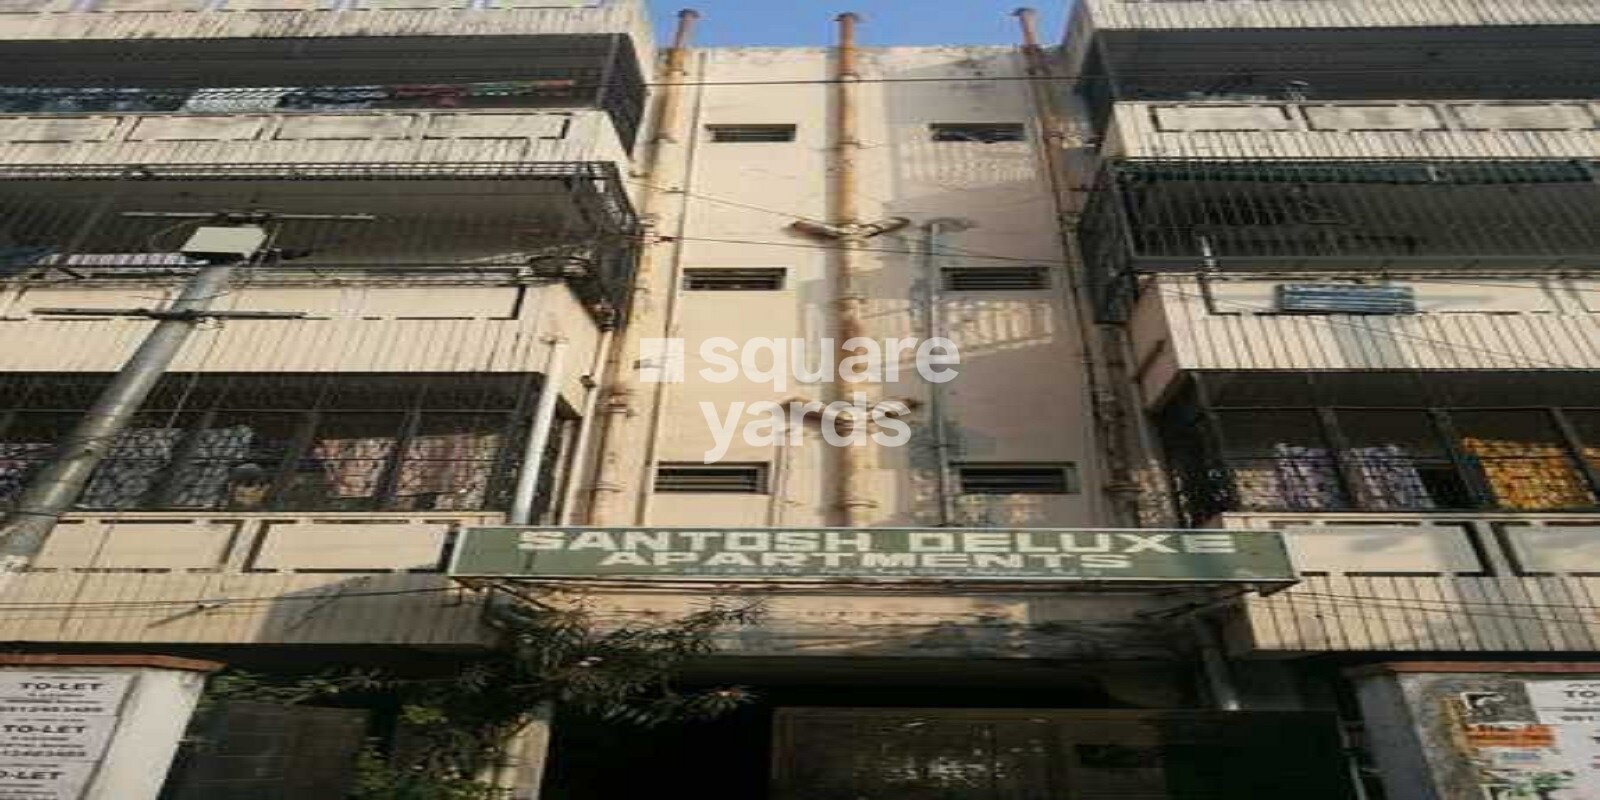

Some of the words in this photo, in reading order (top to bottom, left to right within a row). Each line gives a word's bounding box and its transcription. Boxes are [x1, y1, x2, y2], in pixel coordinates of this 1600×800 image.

[517, 530, 873, 553] SANTOSH
[909, 531, 1237, 554] DELUXE
[599, 551, 1133, 569] APARTMENTS
